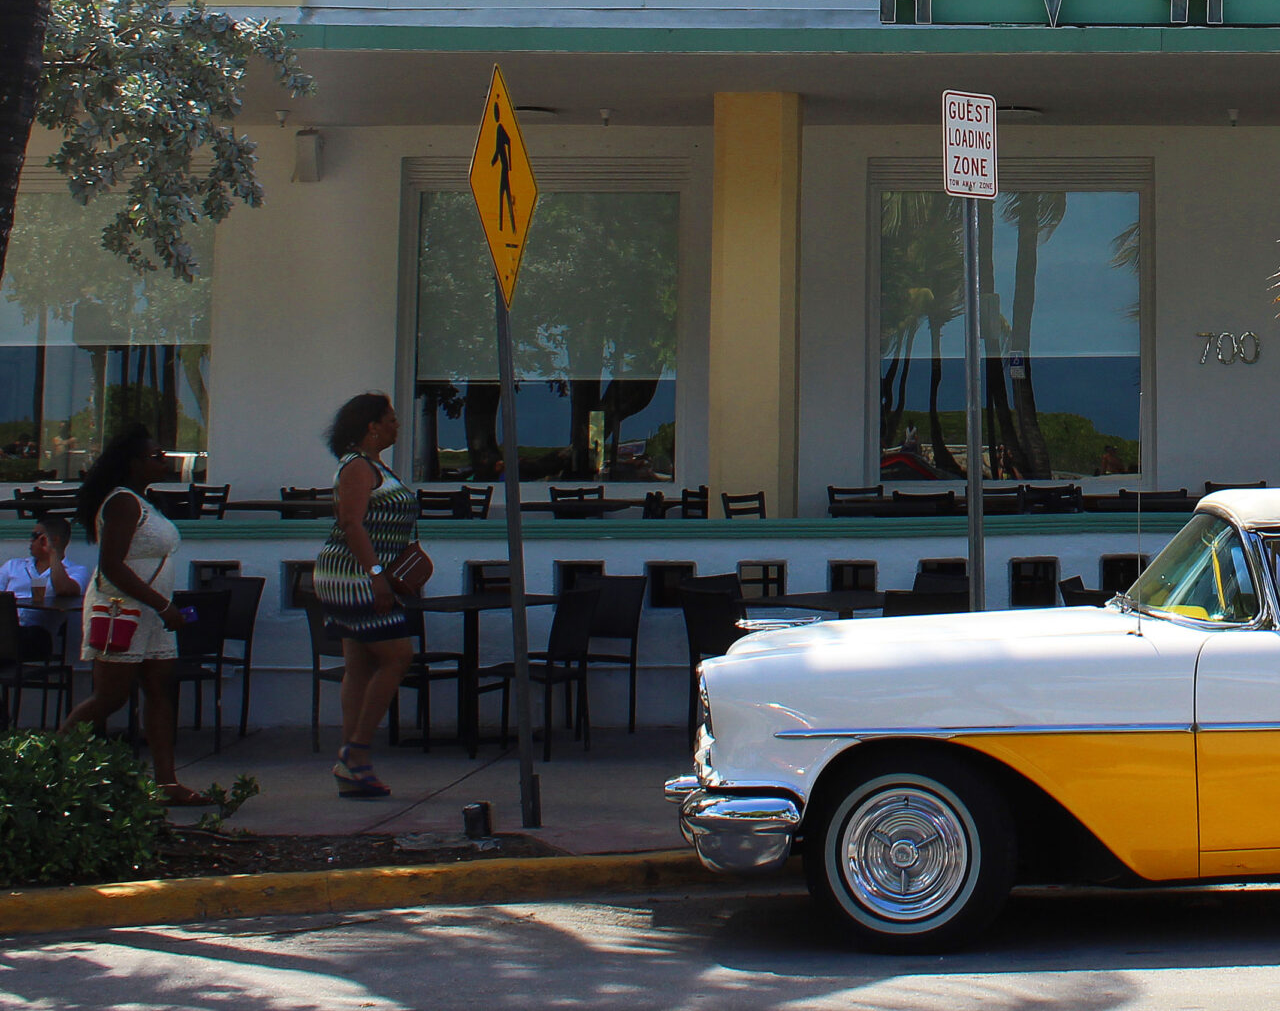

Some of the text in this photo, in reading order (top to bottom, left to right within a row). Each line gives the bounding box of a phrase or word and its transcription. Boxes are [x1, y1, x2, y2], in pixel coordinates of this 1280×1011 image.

[948, 101, 991, 124] GUEST
[948, 127, 991, 150] LOADING
[953, 155, 988, 177] ZONE
[949, 178, 993, 190] TOW AWAY ZONE
[1195, 331, 1260, 364] 700
